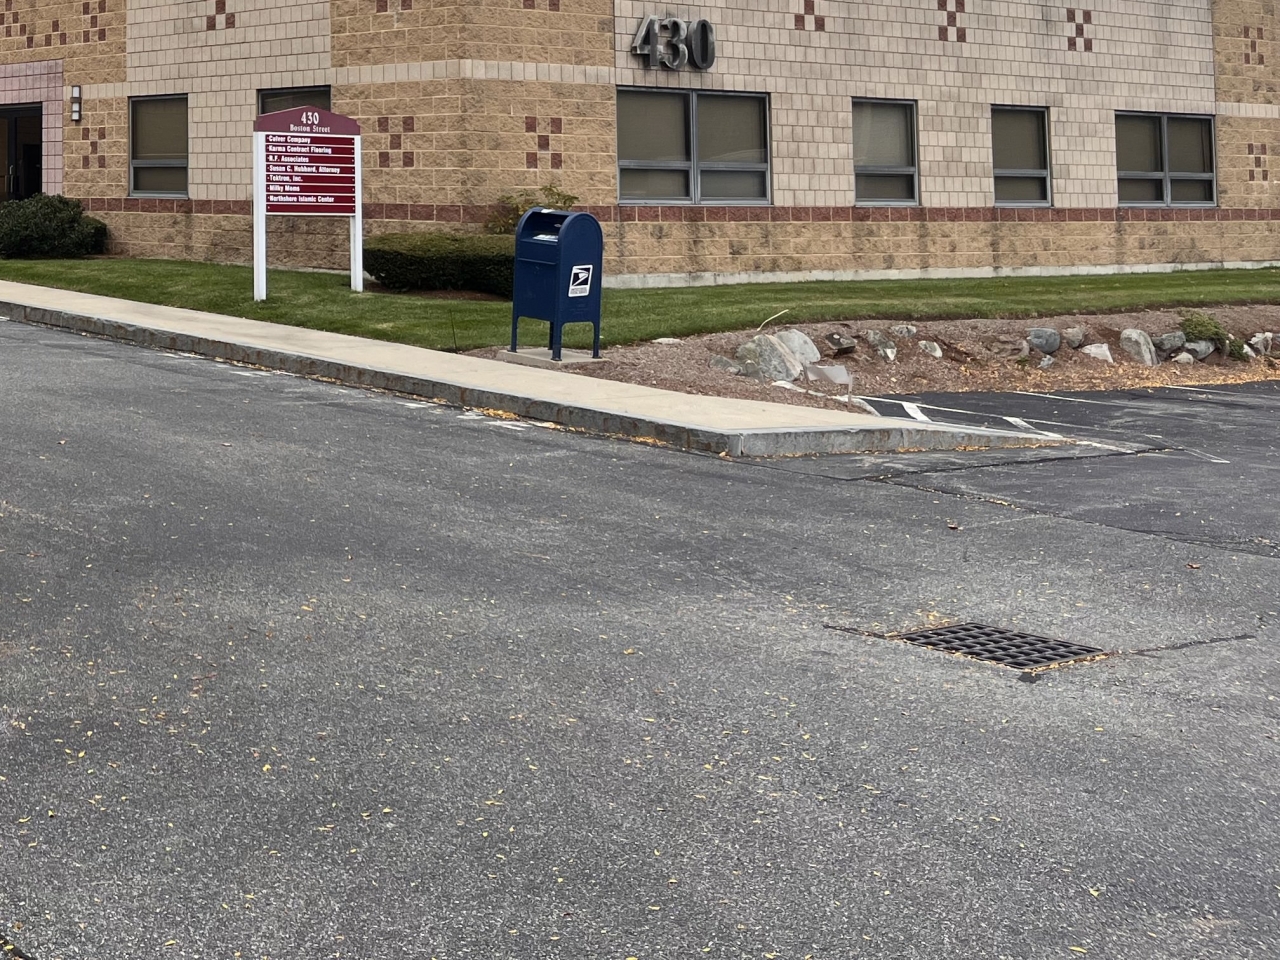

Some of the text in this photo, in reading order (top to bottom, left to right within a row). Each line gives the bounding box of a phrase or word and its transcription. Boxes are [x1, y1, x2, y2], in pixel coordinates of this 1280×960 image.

[631, 15, 715, 70] 430
[301, 112, 319, 124] 430
[290, 124, 330, 133] Boston Street
[287, 136, 311, 144] Company
[319, 166, 340, 174] Attorney
